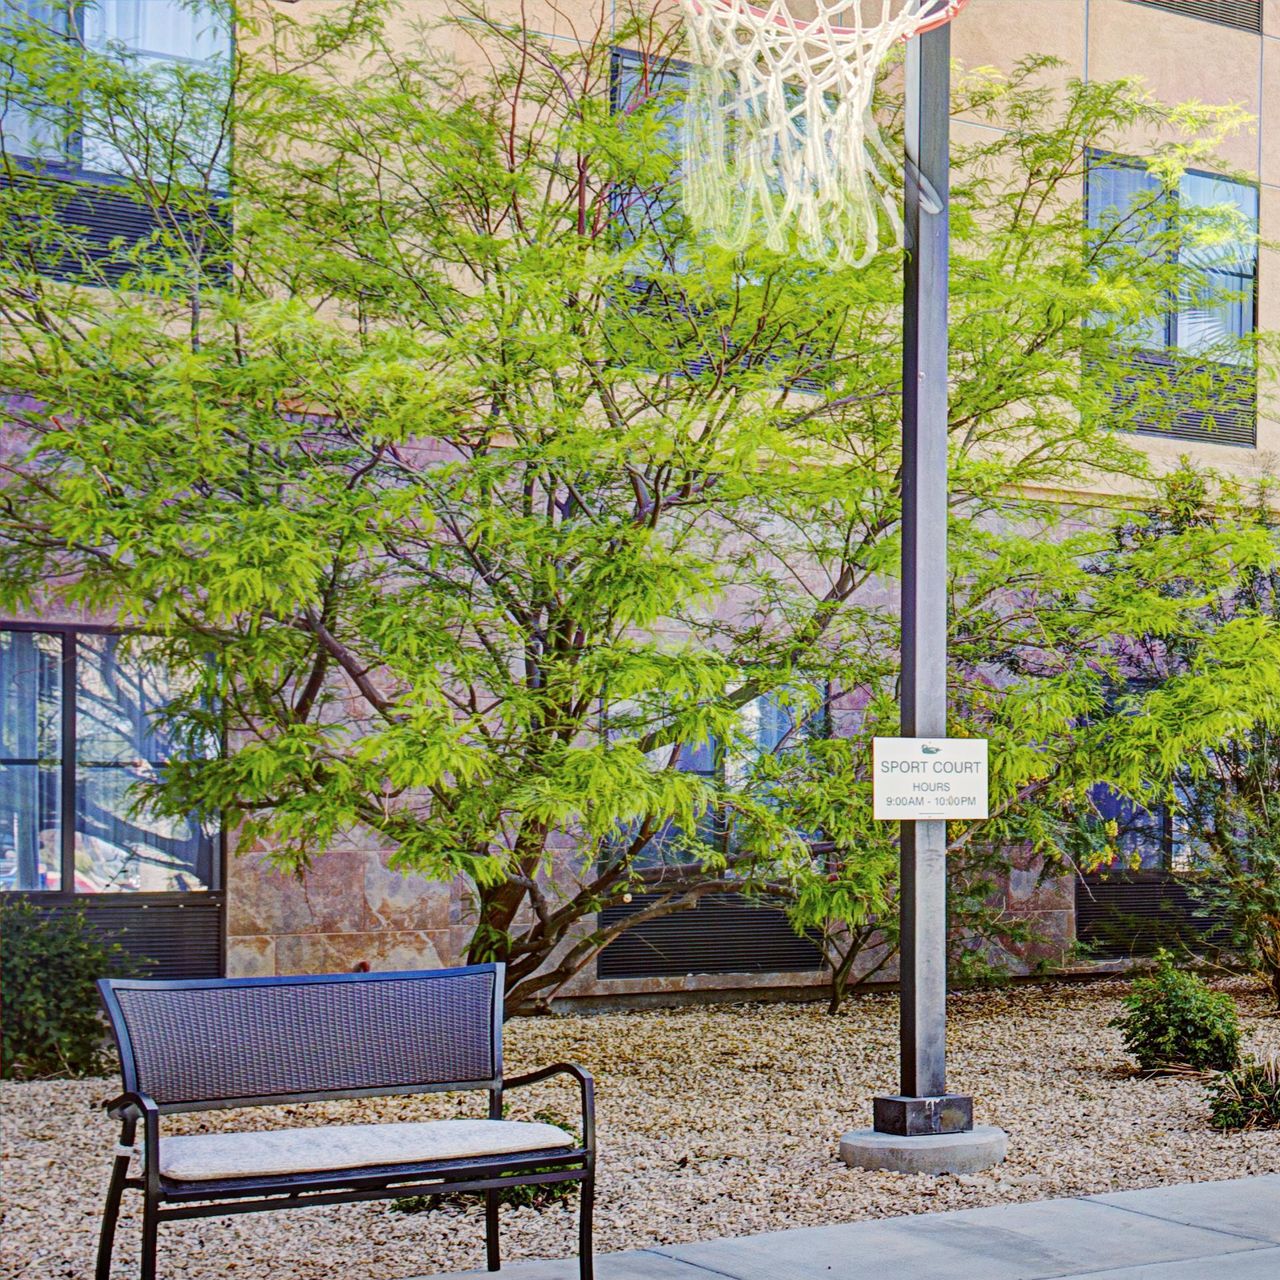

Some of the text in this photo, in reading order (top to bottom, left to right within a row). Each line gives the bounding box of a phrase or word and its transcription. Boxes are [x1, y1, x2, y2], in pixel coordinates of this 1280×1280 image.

[881, 761, 981, 773] SPORT COURT
[912, 782, 951, 792] HOURS
[886, 796, 925, 807] 9:00AM
[935, 796, 977, 807] 10:00PM
